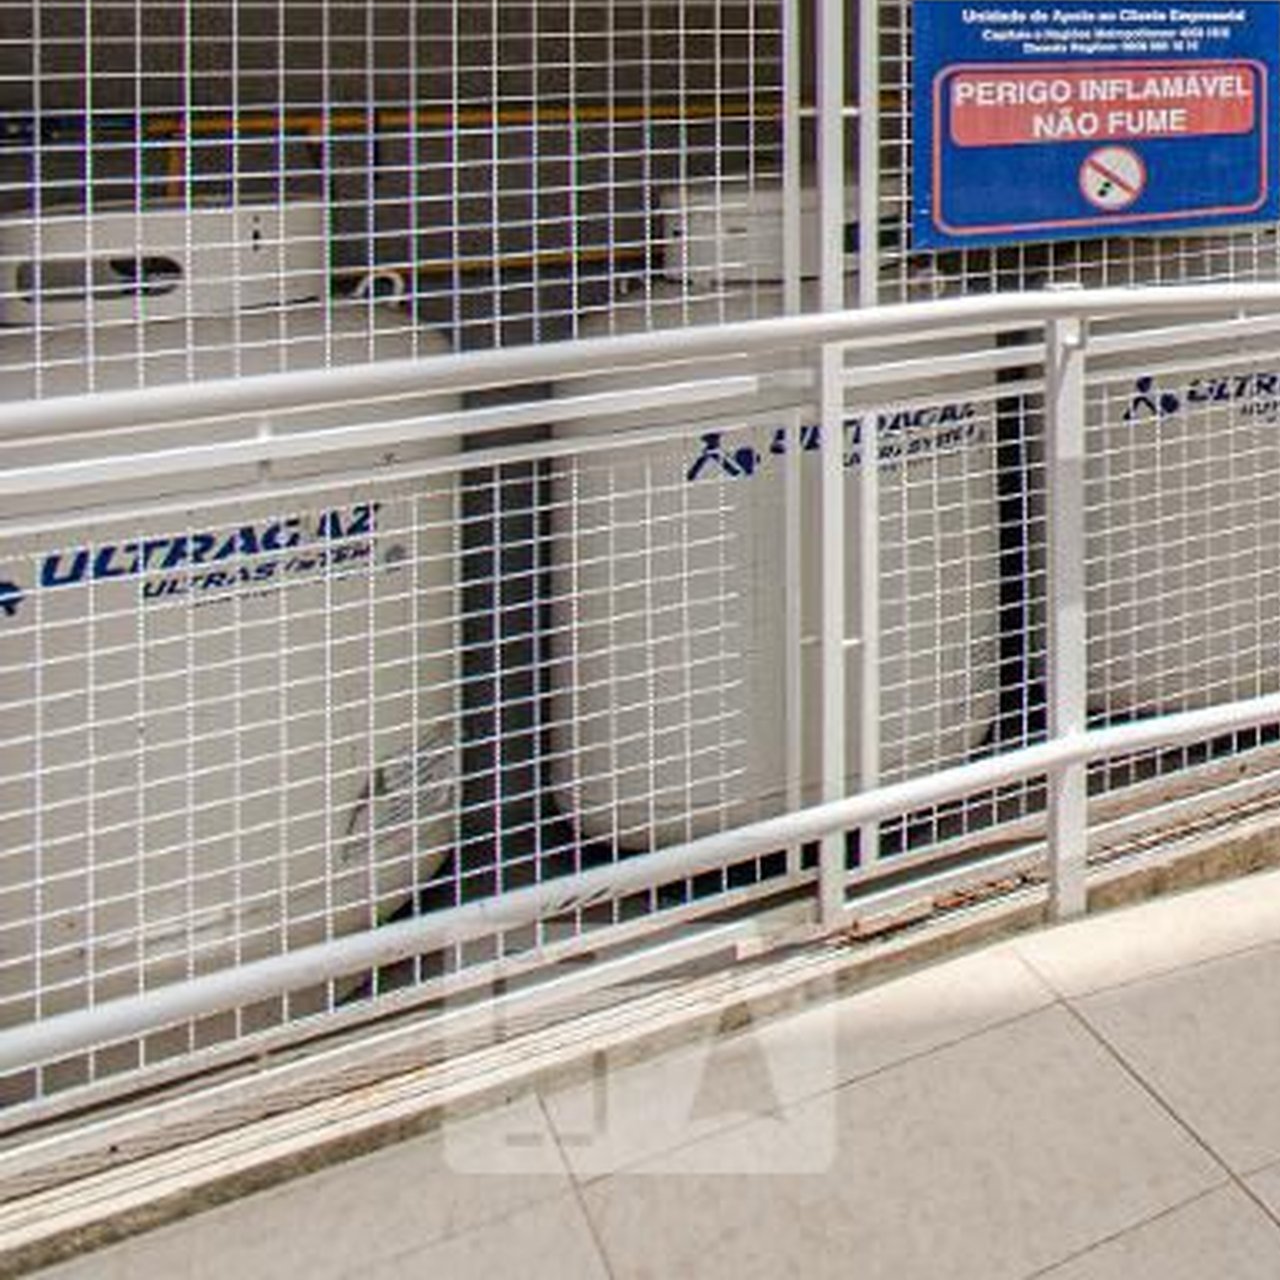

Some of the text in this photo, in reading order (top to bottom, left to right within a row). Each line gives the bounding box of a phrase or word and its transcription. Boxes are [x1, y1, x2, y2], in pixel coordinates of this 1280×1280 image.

[953, 72, 1253, 108] PERIGO INFLAMÁVEL
[1030, 106, 1188, 139] NÃO FUME
[40, 502, 381, 588] ULTRAGAZ
